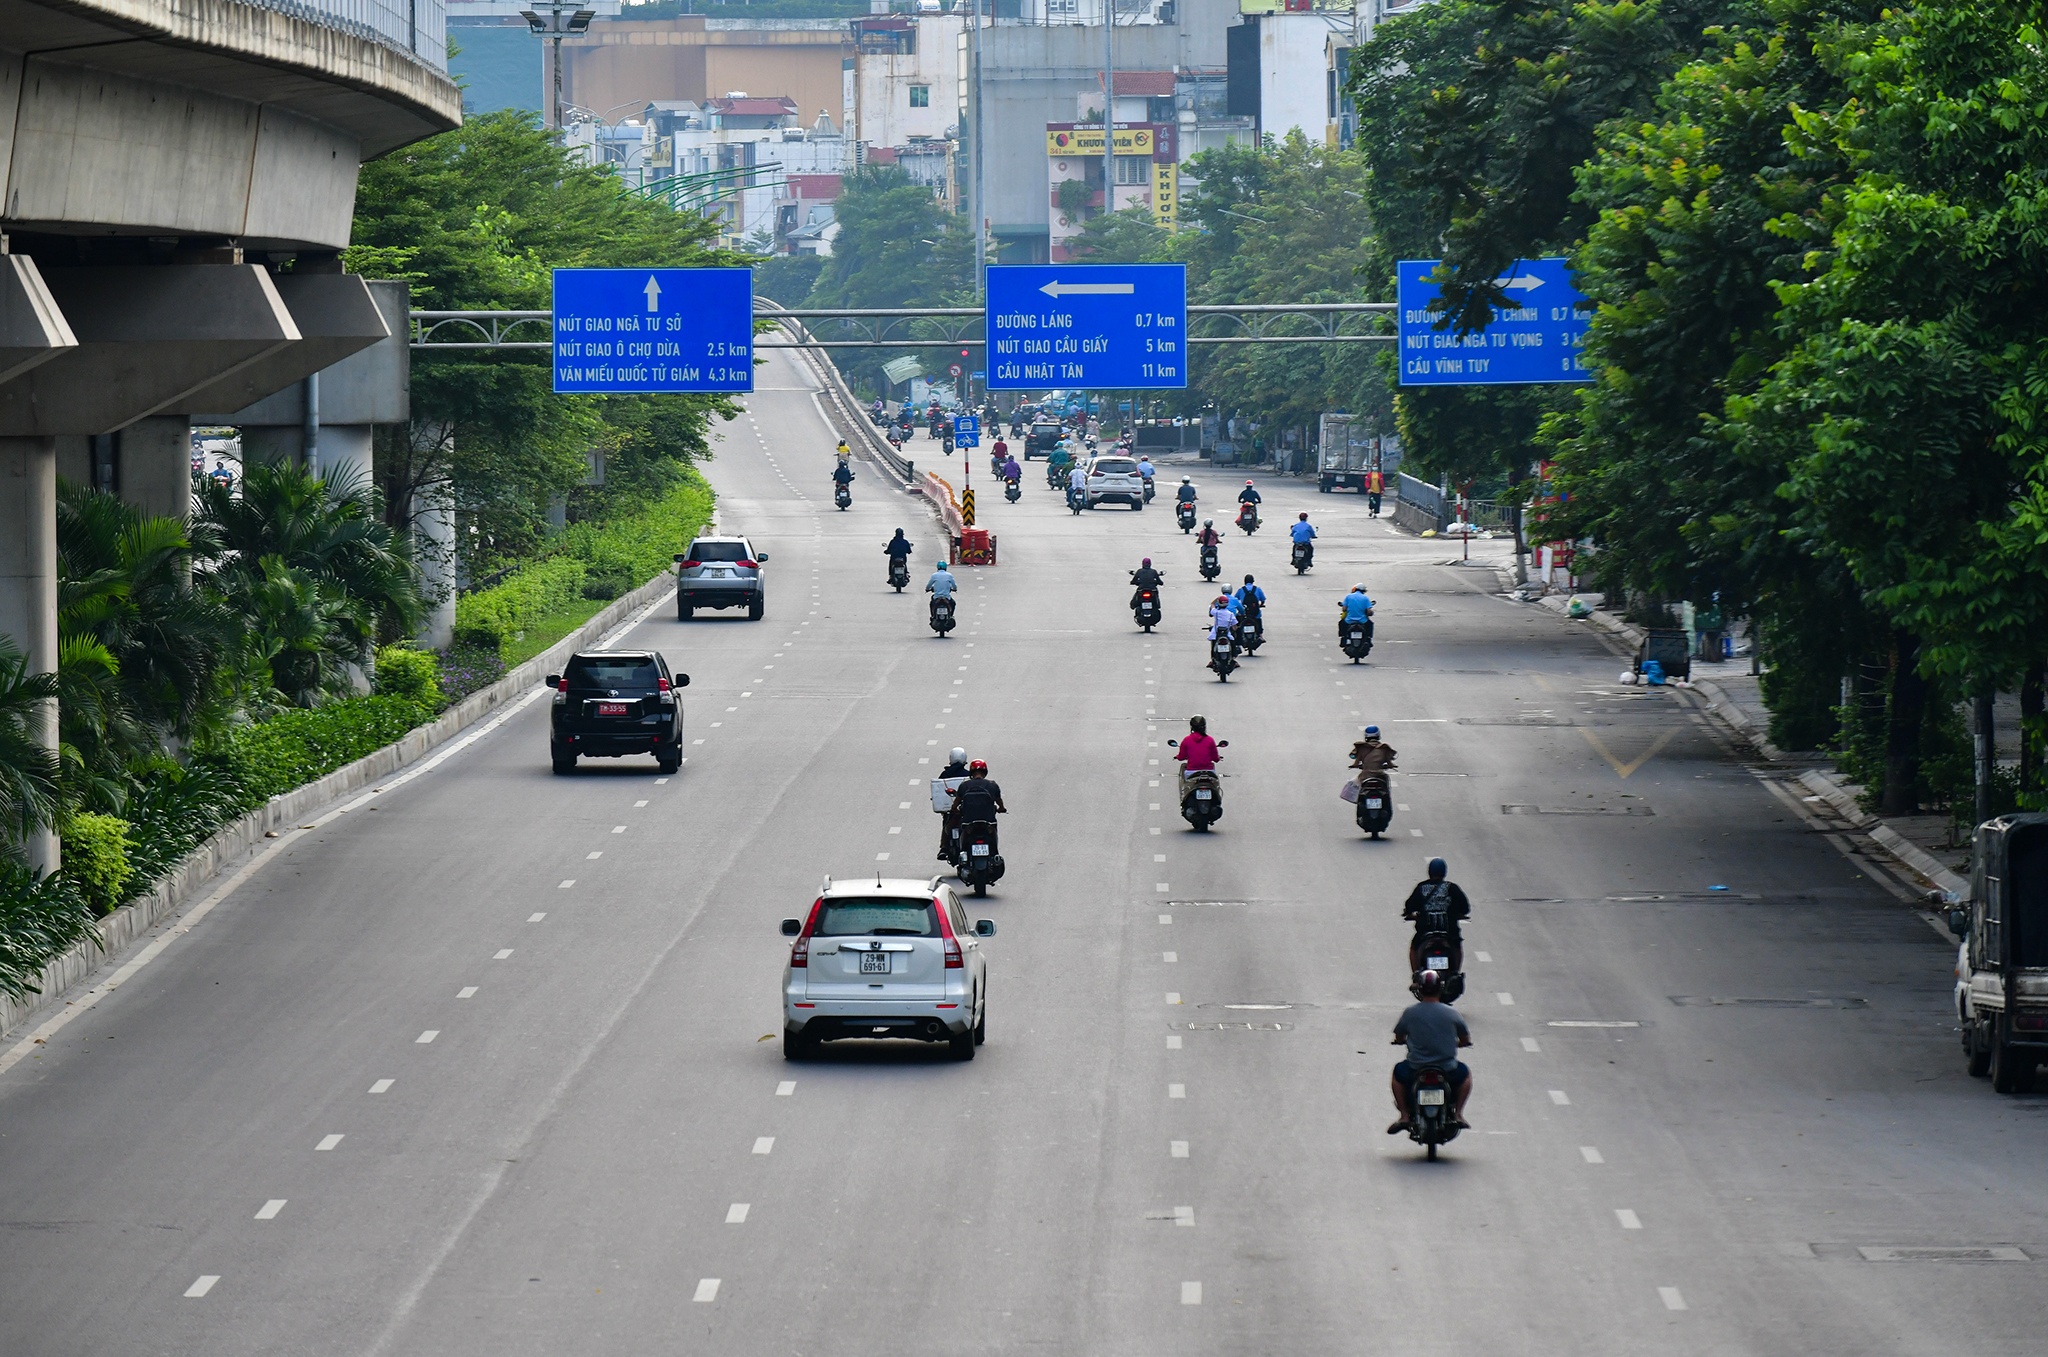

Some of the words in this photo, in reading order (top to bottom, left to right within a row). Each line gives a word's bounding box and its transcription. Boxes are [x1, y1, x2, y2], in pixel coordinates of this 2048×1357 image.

[1077, 138, 1106, 147] KHƯƠN
[1113, 137, 1132, 147] VIÊN
[1160, 171, 1171, 229] KHƯƠN
[559, 314, 581, 331] NÚT
[585, 318, 612, 331] GIAO
[617, 314, 640, 331] NGÃ
[646, 316, 661, 331] TƯ
[666, 313, 682, 331] SỞ
[996, 310, 1037, 328] ĐƯỜNG
[1042, 310, 1072, 328] LÁNG
[1157, 313, 1175, 327] km
[997, 335, 1020, 353] NÚT
[1024, 340, 1050, 353] GIAO
[1056, 335, 1078, 353] CẦU
[1083, 334, 1108, 353] GIẤY
[1146, 338, 1153, 352] 5
[1157, 338, 1176, 352] km
[1407, 330, 1430, 349] NÚT
[1491, 333, 1507, 347] TƯ
[1511, 333, 1543, 350] VỌNG
[1561, 332, 1569, 346] 3
[559, 339, 581, 356] NÚT
[585, 343, 612, 356] GIAO
[617, 340, 624, 356] Ô
[629, 342, 652, 359] CHỢ
[657, 338, 680, 356] DỪA
[708, 343, 724, 357] 2,5
[730, 343, 746, 356] km
[560, 365, 582, 381] VĂN
[586, 363, 613, 381] MIẾU
[617, 363, 648, 382] QUỐC
[652, 363, 667, 381] TỬ
[671, 364, 699, 381] GIÁM
[998, 361, 1020, 378] CẦU
[1025, 362, 1055, 381] NHẬT
[1061, 362, 1083, 378] TÂN
[1142, 364, 1153, 377] 11
[1158, 364, 1176, 377] km
[1407, 356, 1430, 374] CẦU
[1435, 357, 1462, 373] VĨNH
[1468, 359, 1490, 373] TUY
[1562, 358, 1570, 371] 8
[708, 368, 725, 382] 4,3
[730, 368, 747, 381] km
